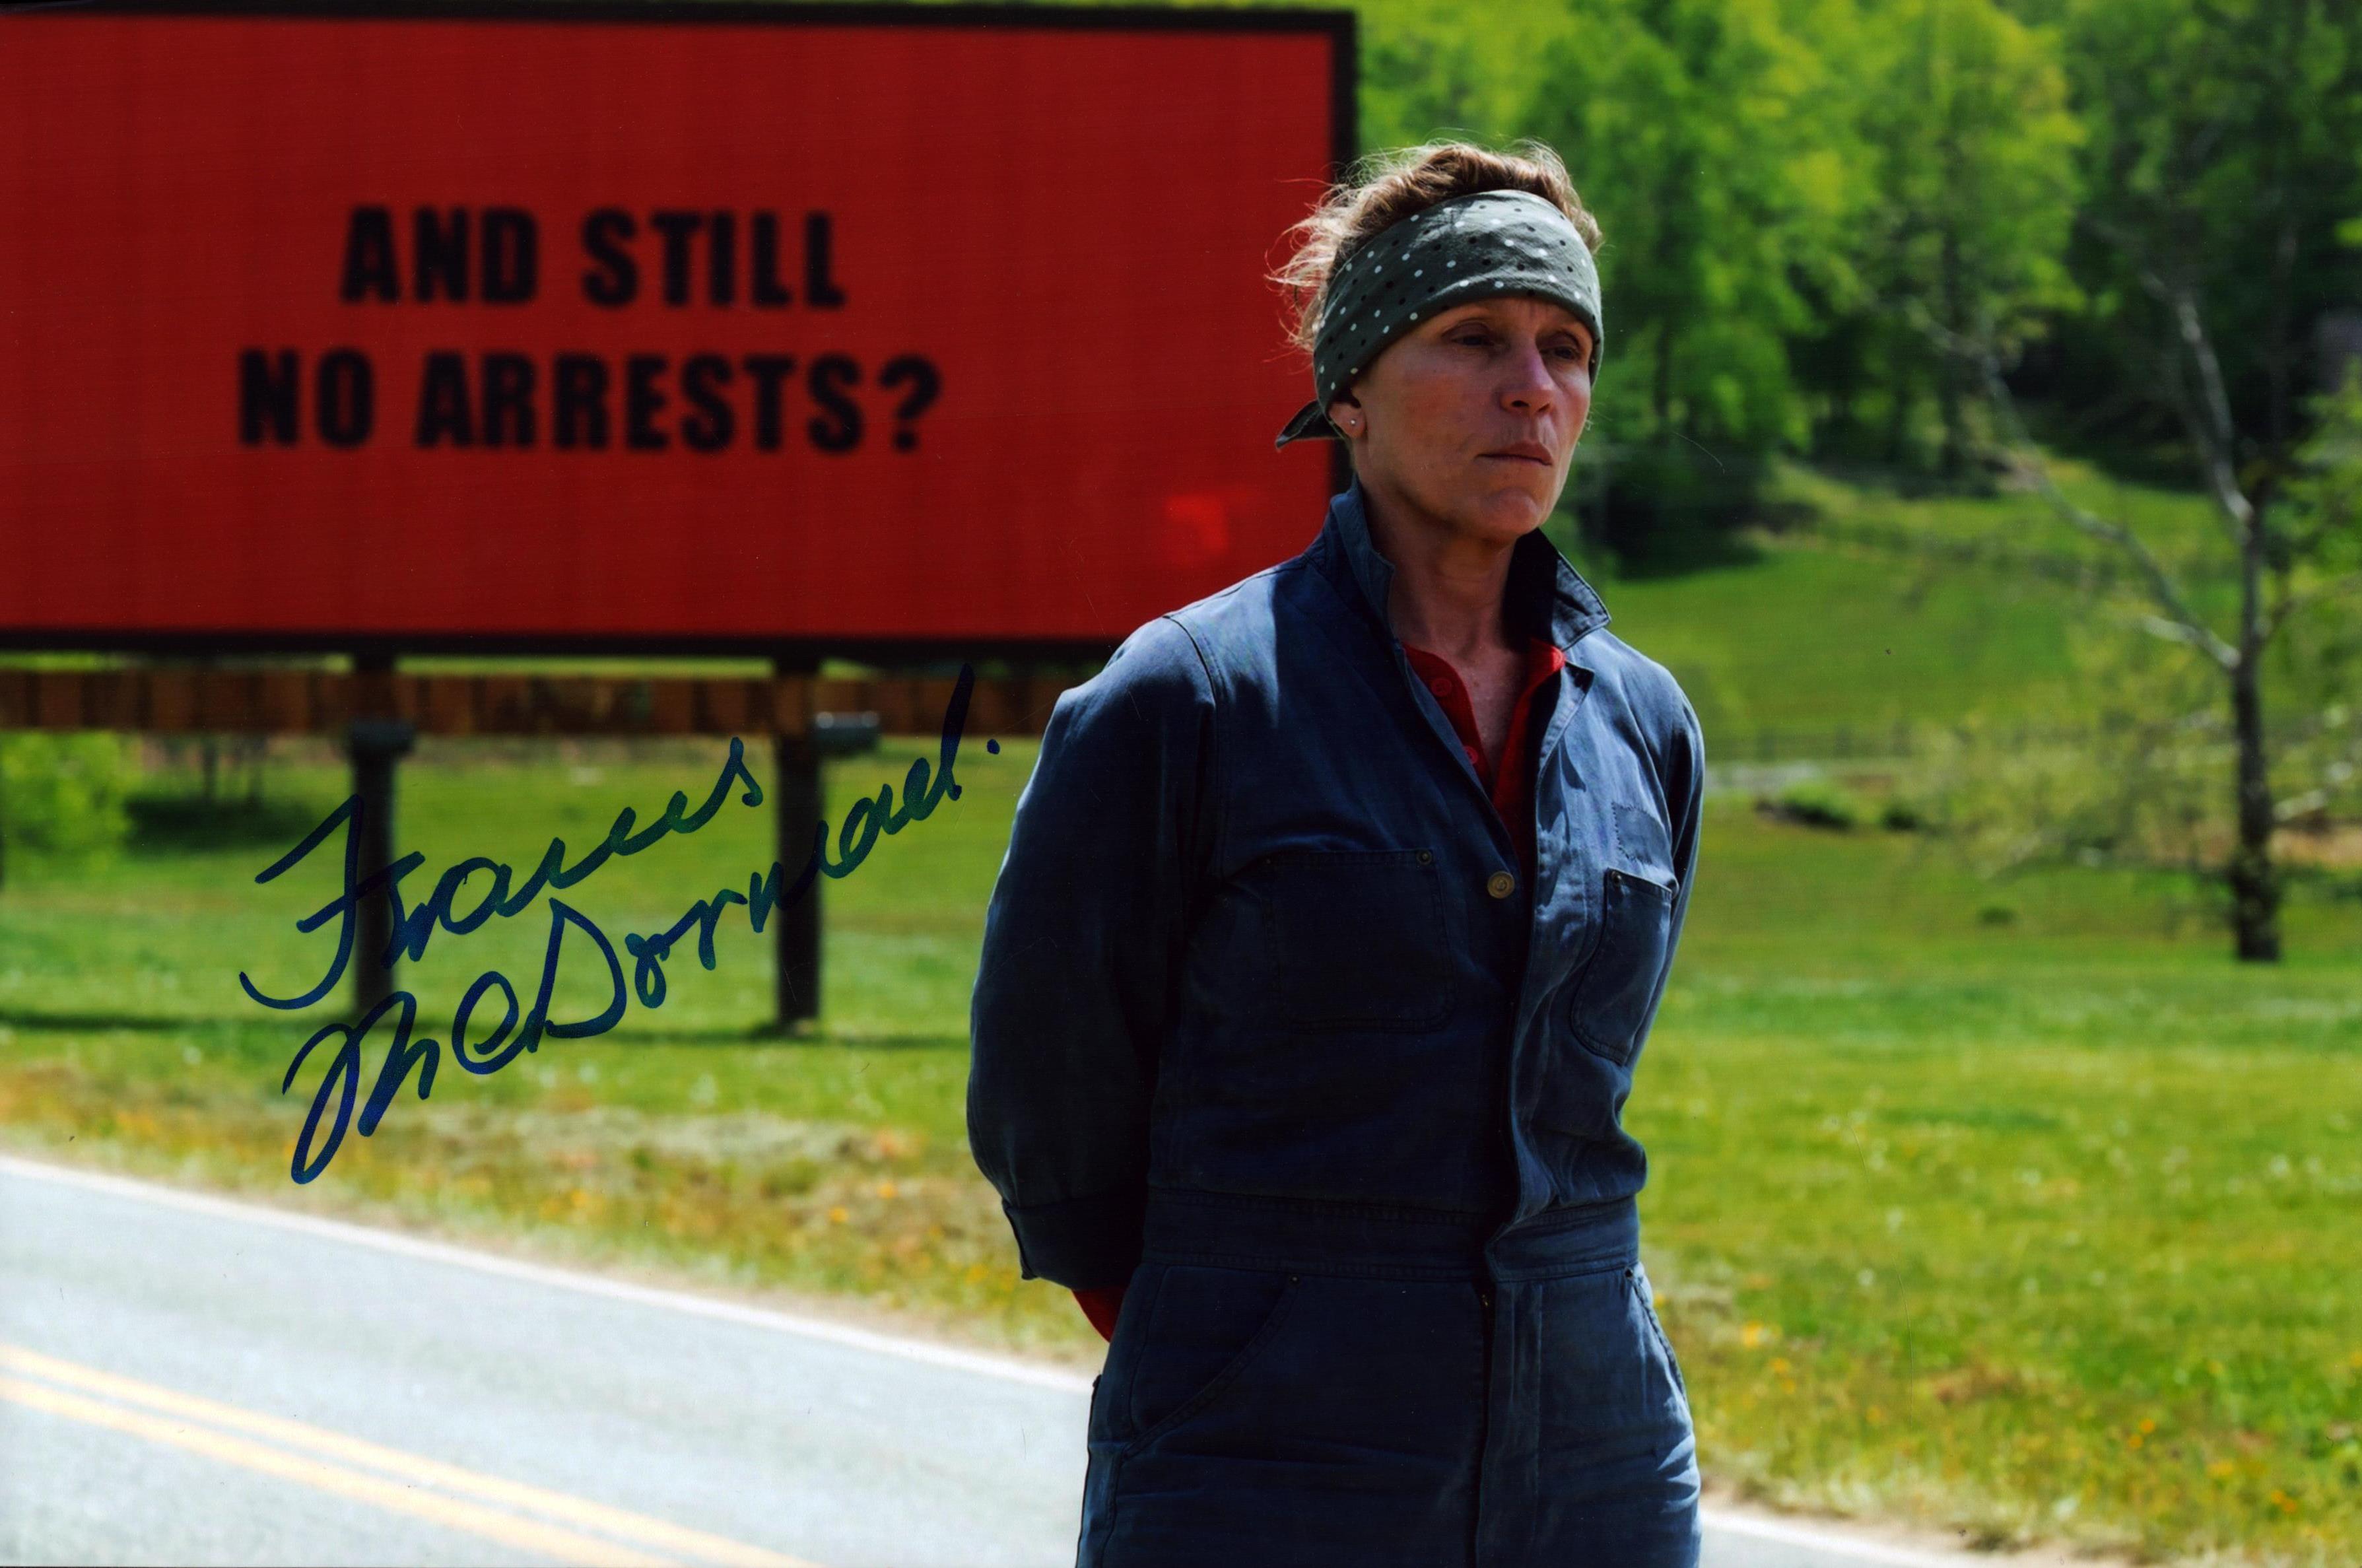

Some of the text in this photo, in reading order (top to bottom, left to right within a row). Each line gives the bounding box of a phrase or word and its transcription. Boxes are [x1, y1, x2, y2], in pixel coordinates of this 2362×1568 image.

[341, 205, 847, 309] AND STILL
[238, 348, 942, 454] NO ARRESTS?
